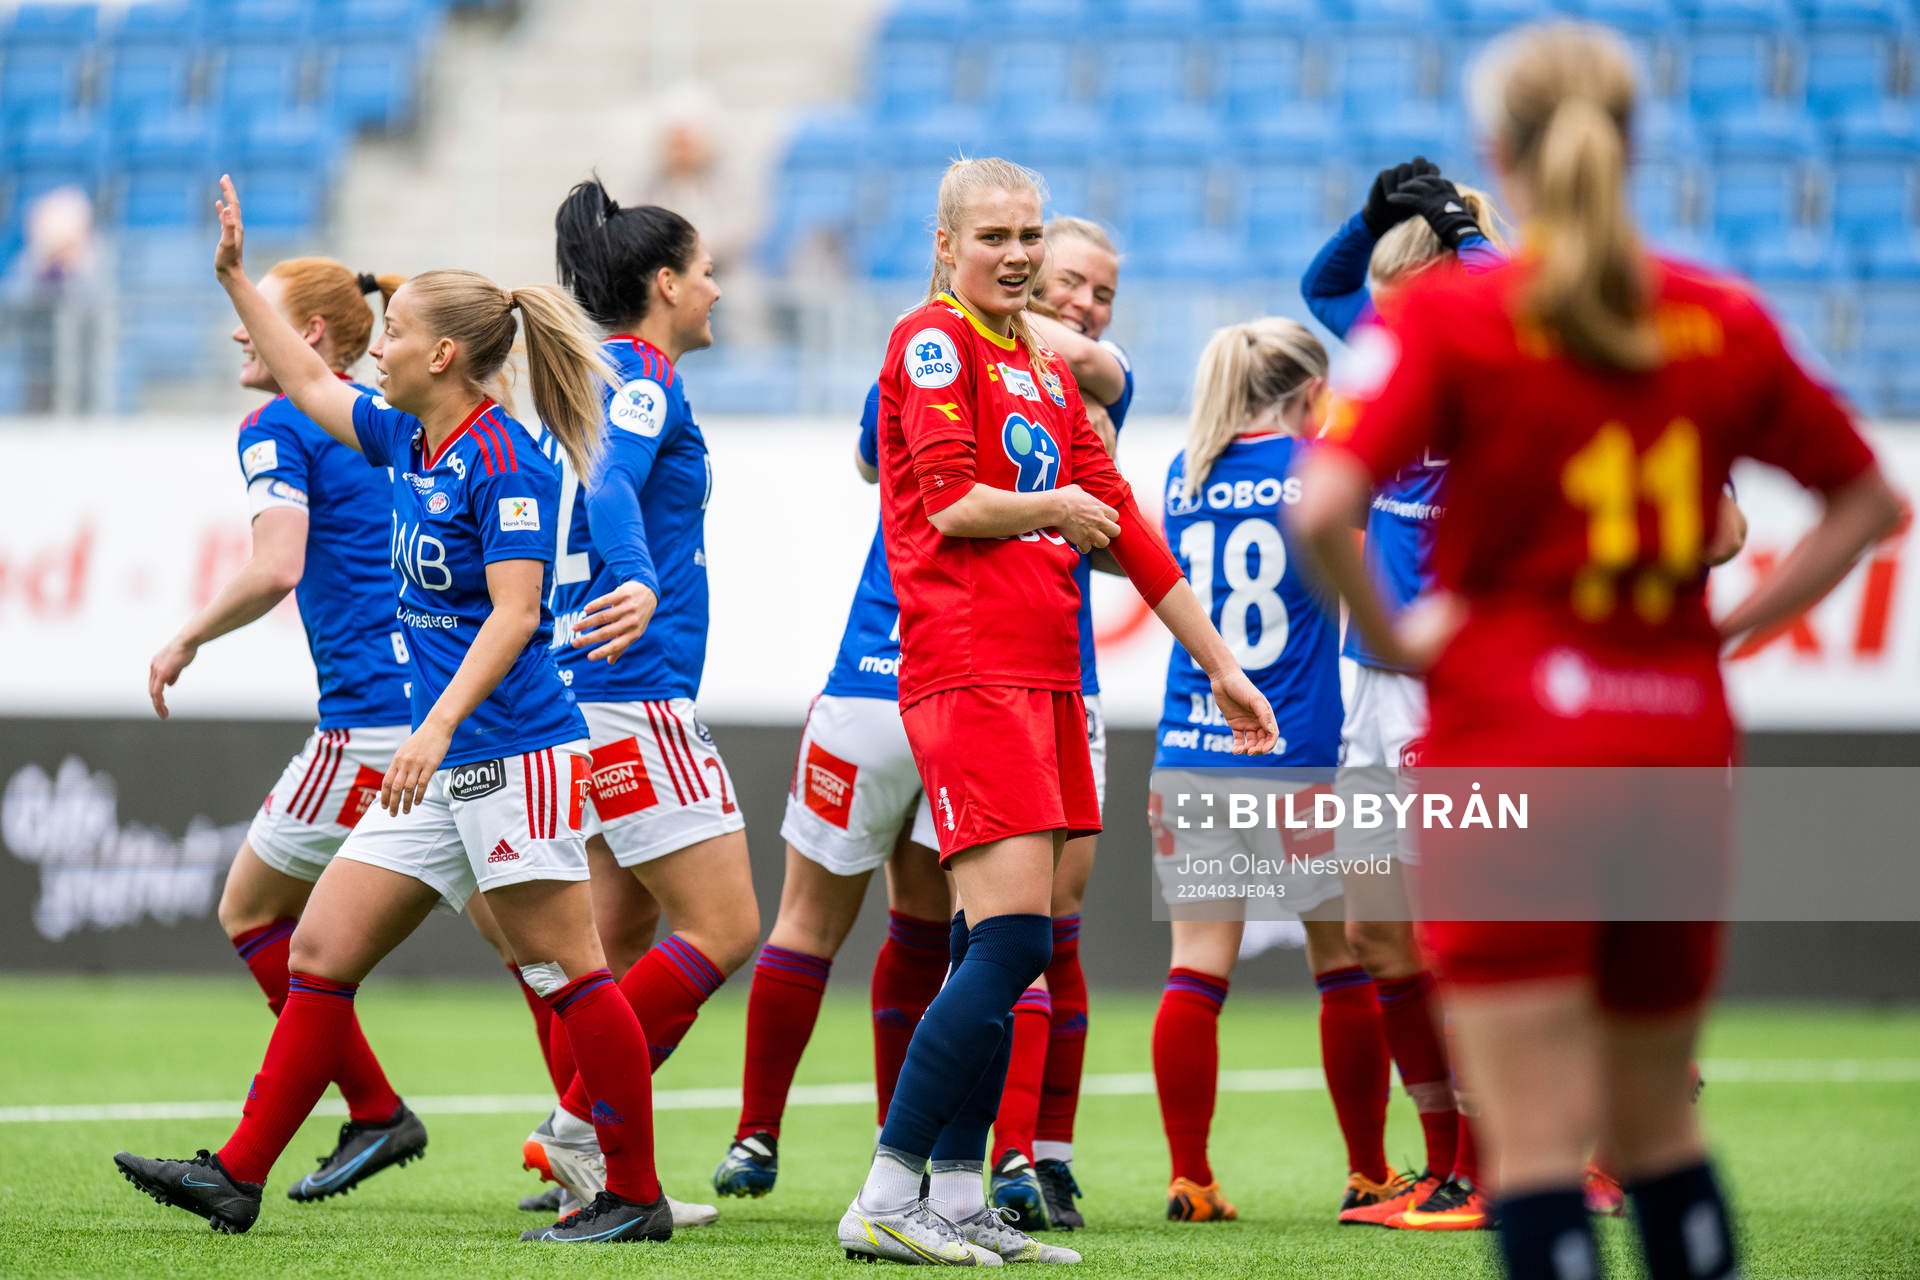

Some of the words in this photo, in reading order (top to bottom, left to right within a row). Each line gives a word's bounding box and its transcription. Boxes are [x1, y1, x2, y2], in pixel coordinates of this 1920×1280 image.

[916, 362, 953, 378] OBOS
[618, 407, 656, 430] OBOS
[1207, 477, 1303, 509] OBOS
[1562, 416, 1702, 571] 11
[520, 519, 537, 528] Tipping
[1179, 517, 1290, 670] 18
[1162, 729, 1200, 750] mot
[455, 763, 496, 788] ooni
[592, 760, 640, 790] THON
[598, 779, 639, 800] HOTELS
[487, 851, 520, 863] adidas
